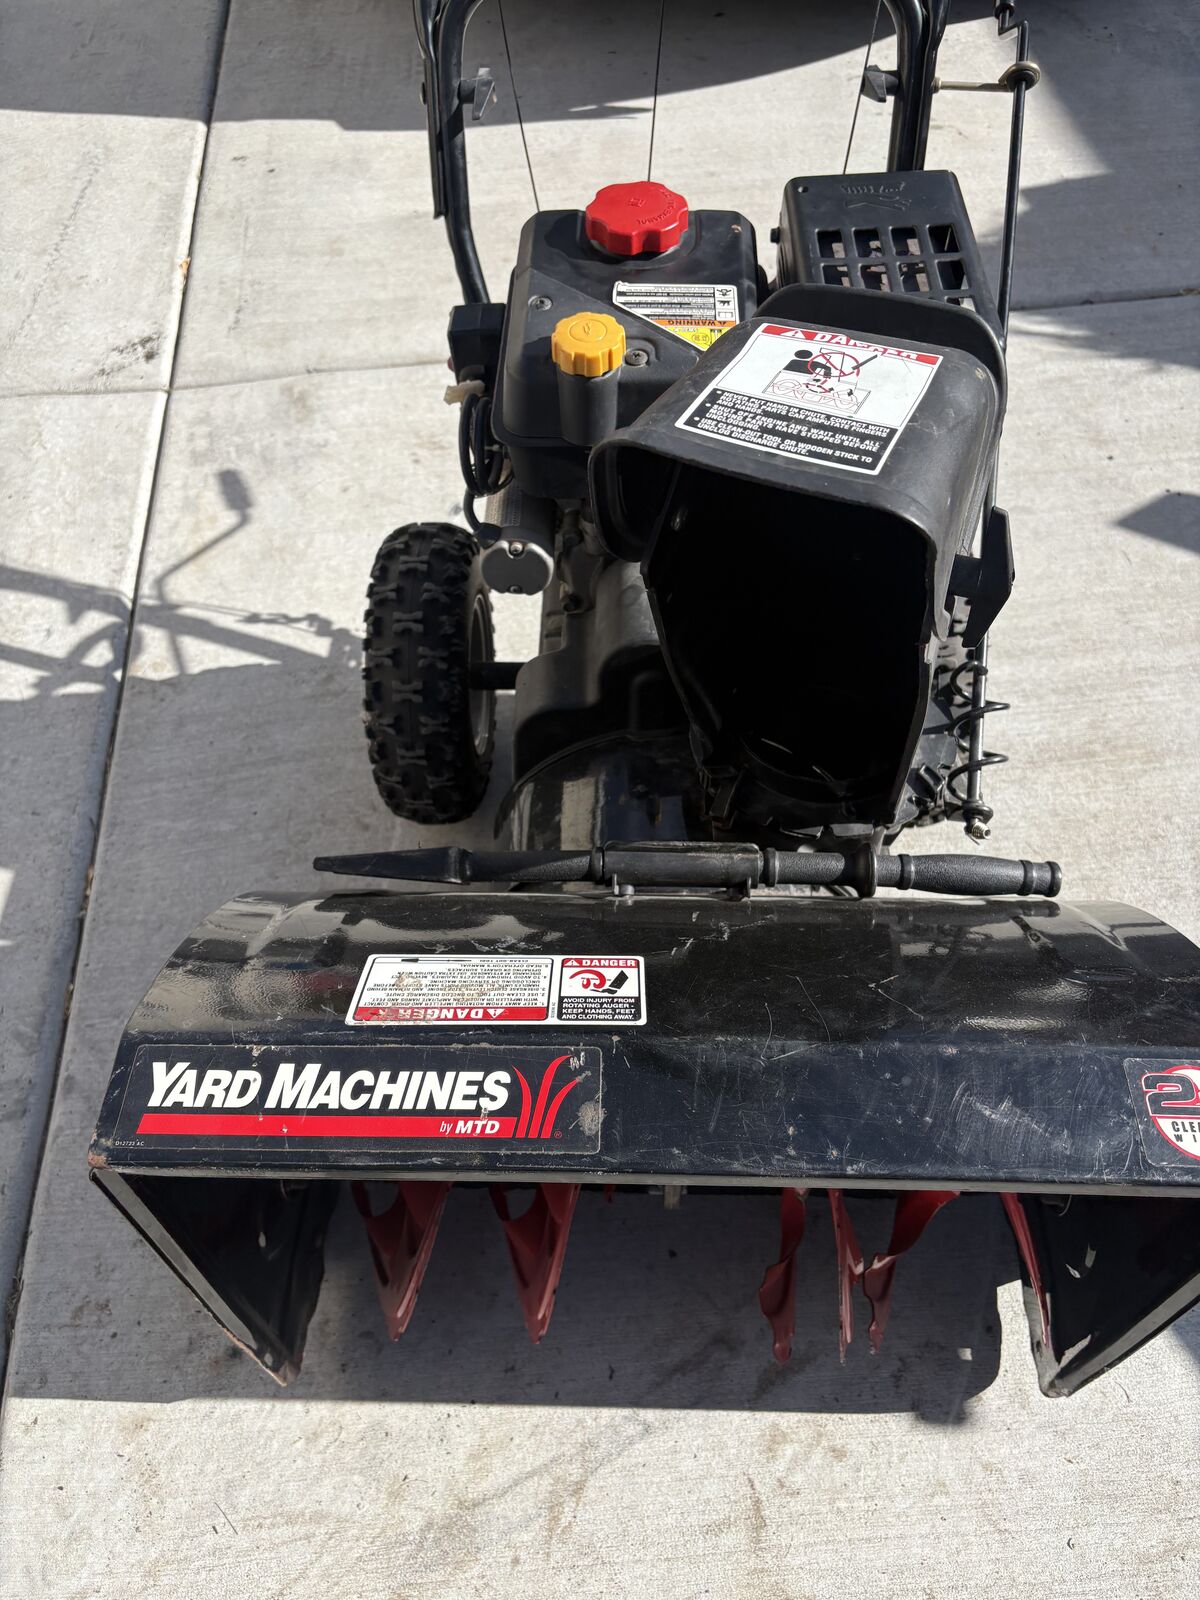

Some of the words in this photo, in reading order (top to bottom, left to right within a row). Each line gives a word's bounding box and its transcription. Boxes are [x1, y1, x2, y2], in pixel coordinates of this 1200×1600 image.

[706, 412, 760, 430] UNCLOGGING.
[712, 404, 736, 414] SHUT
[737, 410, 754, 418] OFF
[756, 415, 788, 425] ENGINE
[788, 424, 808, 432] AND
[810, 428, 834, 436] WAIT
[835, 434, 860, 442] UNTIL
[864, 440, 880, 448] ALL
[720, 396, 760, 408] ROTATING
[760, 405, 788, 415] PARTS
[788, 411, 806, 420] CAN
[806, 416, 850, 430] AMPUTATE
[852, 426, 888, 438] FINGERS
[722, 392, 748, 402] NEVER
[766, 402, 788, 410] HAND
[830, 416, 867, 428] CONTACT
[869, 424, 890, 433] WITH
[734, 404, 764, 414] HANDS.
[697, 422, 730, 436] UNCLOG
[731, 432, 780, 448] DISCHARGE
[780, 444, 809, 455] CHUTE.
[710, 408, 744, 420] MOVING
[745, 418, 773, 428] PARTS
[775, 425, 798, 434] HAVE
[800, 432, 841, 444] STOPPED
[843, 440, 880, 452] BEFORE
[718, 422, 762, 438] CLEAN-OUT
[762, 434, 782, 444] TOOL
[798, 442, 834, 455] WOODEN
[834, 450, 860, 460] STICK
[398, 1009, 484, 1019] DANGER
[146, 1062, 262, 1108] YARD
[264, 1062, 512, 1112] MACHINES
[1142, 1072, 1200, 1117] 2
[440, 1121, 453, 1134] by
[455, 1120, 500, 1134] MTD
[1171, 1121, 1200, 1134] CLE
